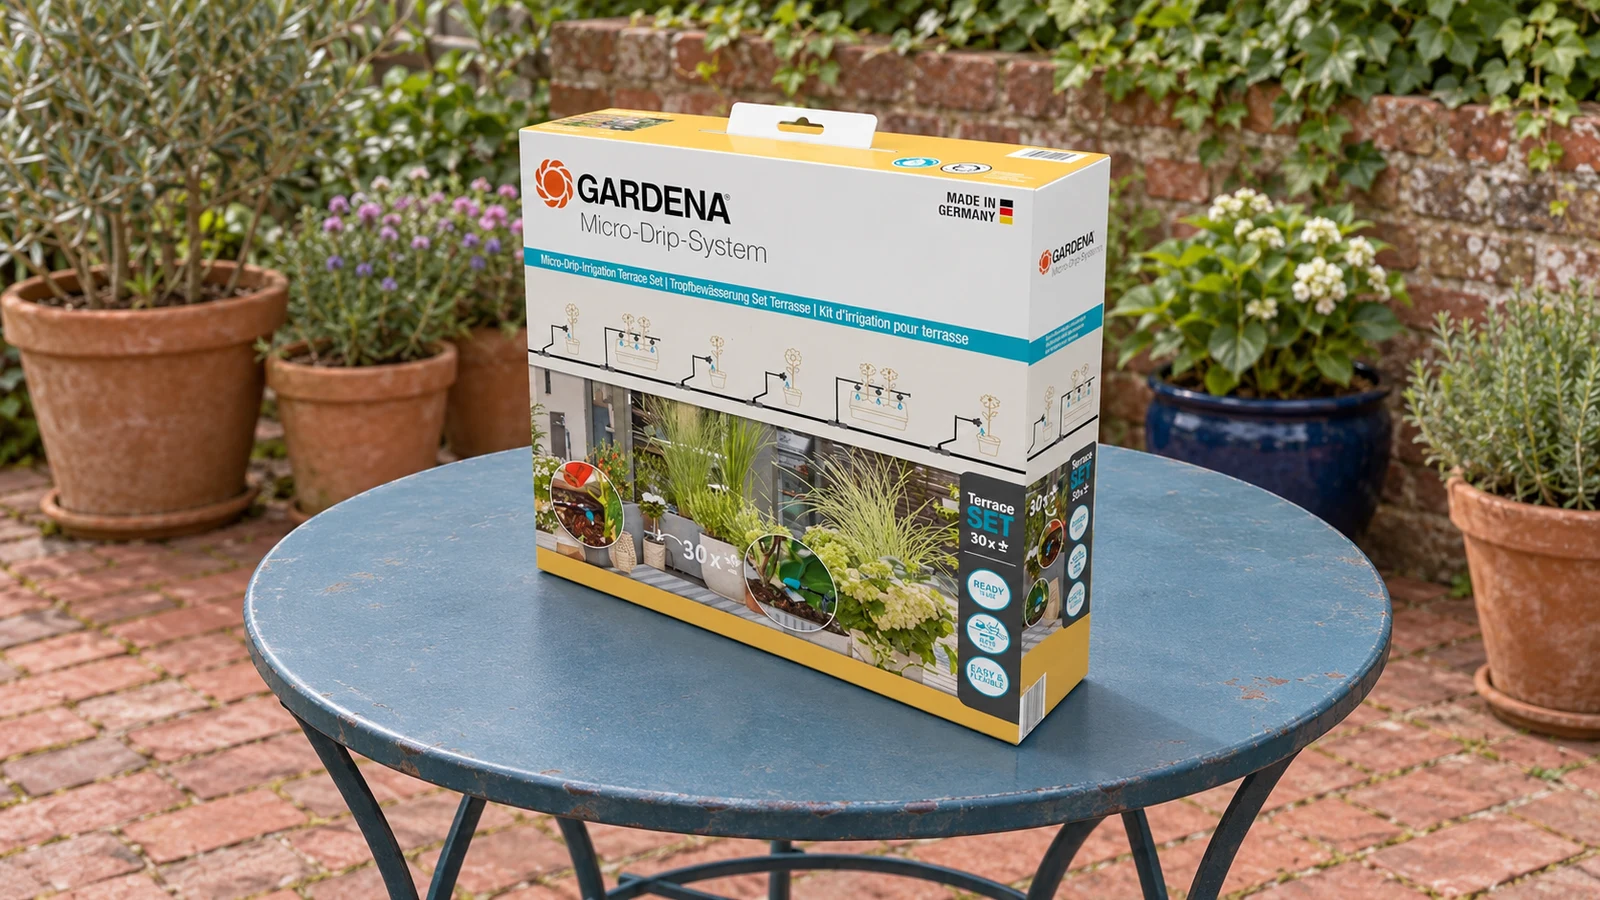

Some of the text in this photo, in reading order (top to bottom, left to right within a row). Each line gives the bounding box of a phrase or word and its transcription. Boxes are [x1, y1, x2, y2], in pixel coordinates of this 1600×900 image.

[947, 191, 996, 209] MADE IN
[938, 205, 996, 223] GERMANY
[580, 212, 768, 264] Micro-Drip-System
[540, 254, 616, 279] Micro-Drip-Irrigation
[617, 268, 648, 284] Terrace
[649, 275, 664, 288] Set
[670, 277, 750, 305] Tropfbewässerung
[751, 292, 768, 307] Set
[770, 296, 811, 314] Terrasse
[819, 305, 833, 319] Kit
[836, 308, 891, 329] d'irrigation
[893, 321, 919, 335] pour
[922, 325, 969, 345] terrasse
[967, 491, 1015, 516] Terrace
[967, 505, 1015, 538] SET
[683, 540, 707, 564] 30
[973, 579, 1005, 596] READY
